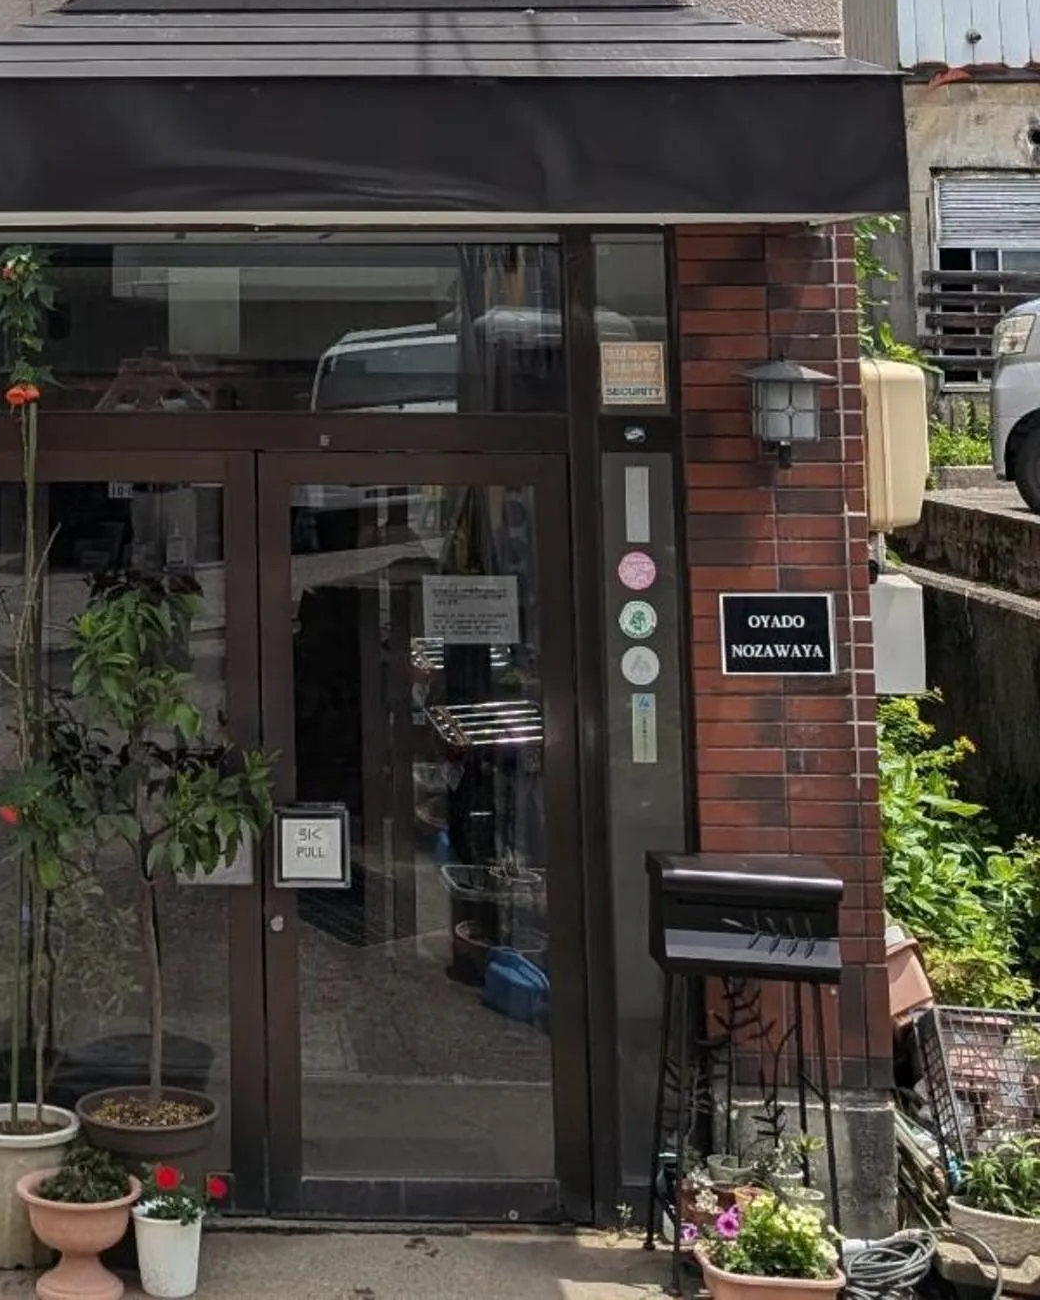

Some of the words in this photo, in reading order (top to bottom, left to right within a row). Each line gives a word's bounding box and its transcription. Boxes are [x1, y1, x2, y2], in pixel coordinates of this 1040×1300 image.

[606, 387, 662, 397] SECURITY
[747, 614, 805, 628] OYADO
[731, 644, 825, 658] NOZAWAYA
[296, 846, 329, 859] PULL
